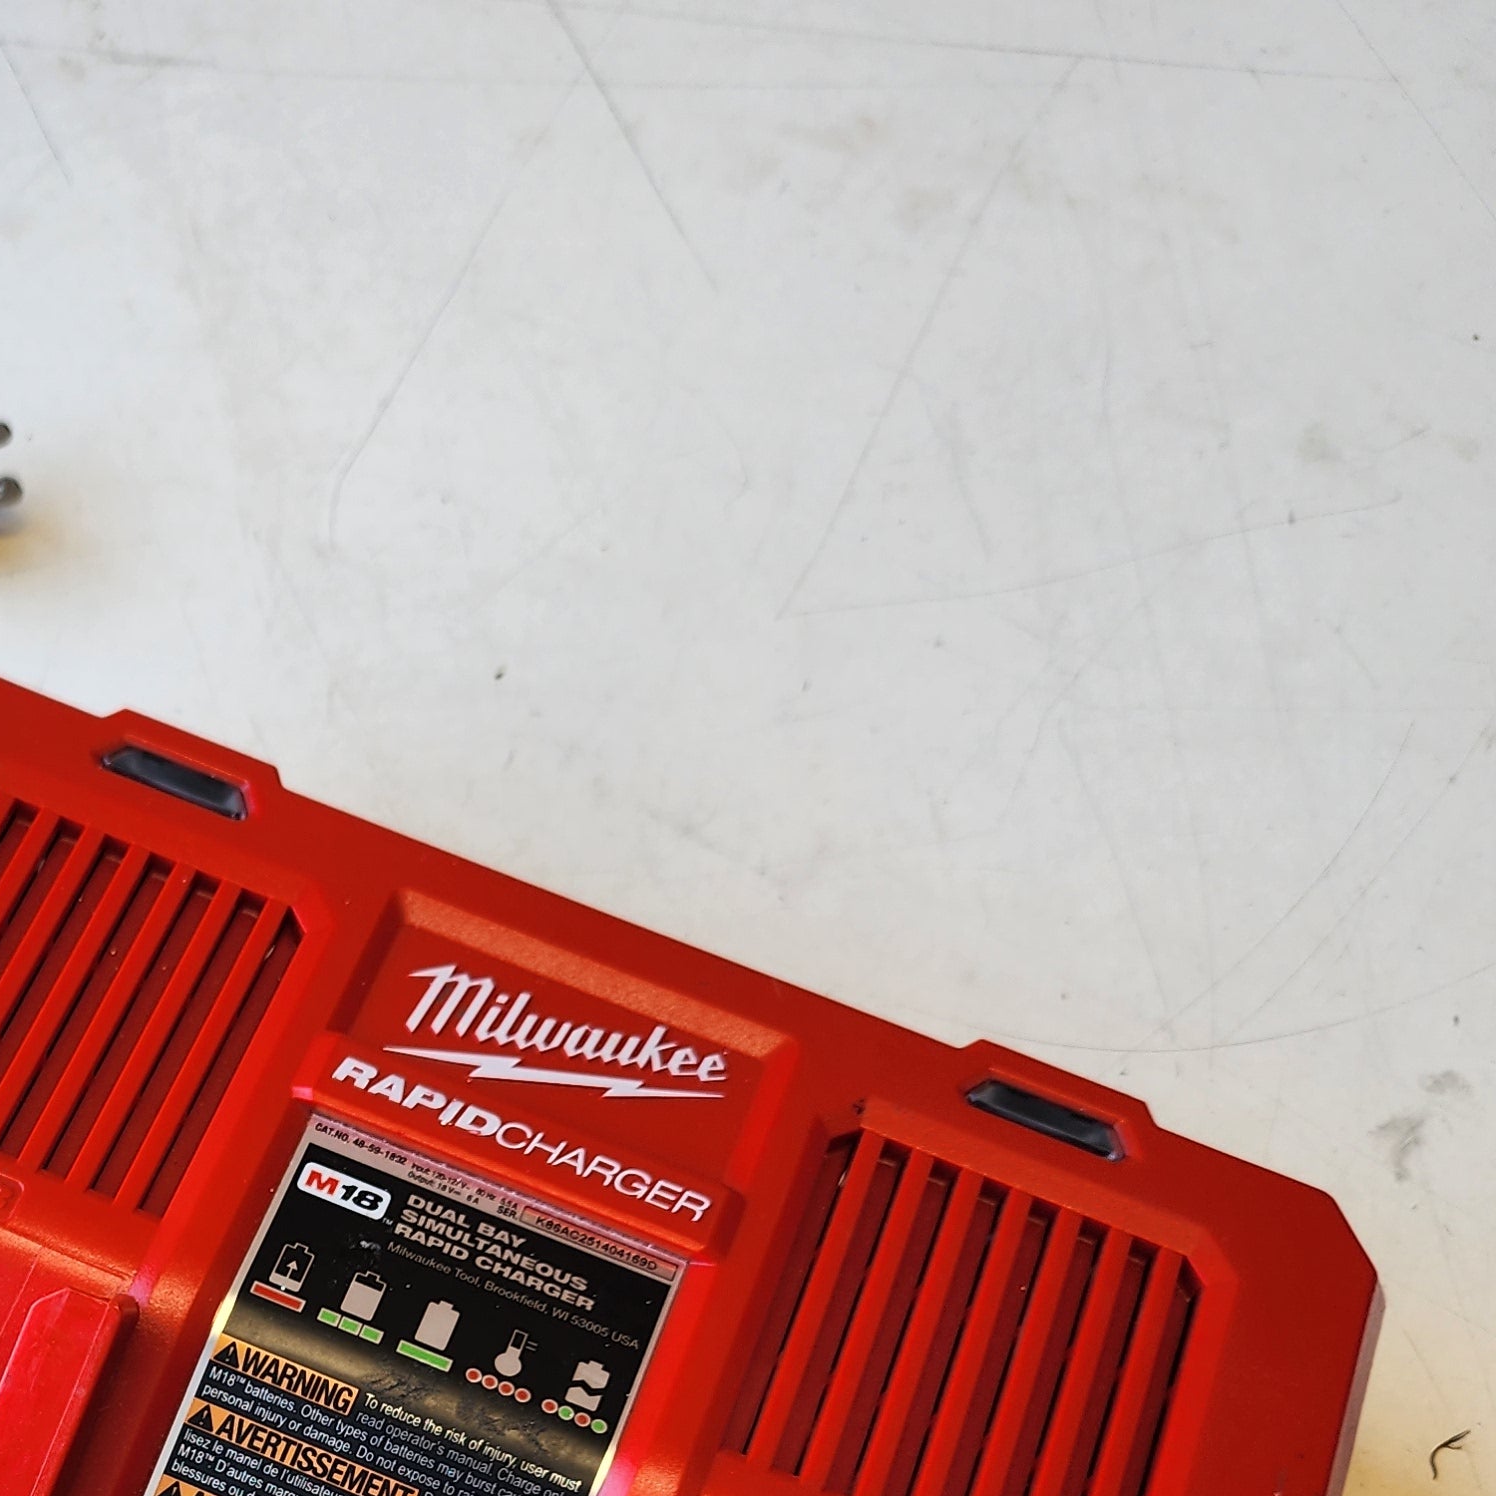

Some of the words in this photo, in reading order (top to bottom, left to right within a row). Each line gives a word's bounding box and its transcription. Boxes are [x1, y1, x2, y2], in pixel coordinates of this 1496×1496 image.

[405, 963, 727, 1082] Milwaukee
[331, 1056, 712, 1223] RAPIDCHARGER
[305, 1169, 384, 1213] M18
[406, 1194, 470, 1229] DUAL
[476, 1222, 527, 1248] BAY
[496, 1205, 518, 1221] SER.
[394, 1222, 470, 1261] RAPID
[474, 1255, 595, 1311] CHARGER
[400, 1208, 588, 1291] SIMULTANEOUS
[387, 1241, 452, 1274] Milwaukee
[454, 1267, 481, 1288] Tool,
[483, 1280, 548, 1315] Brookfield,
[552, 1307, 570, 1321] WI
[570, 1314, 609, 1338] 53005
[611, 1331, 639, 1350] USA
[239, 1348, 354, 1413] WARNING
[171, 1458, 227, 1492] blessures
[183, 1428, 212, 1450] lisez
[211, 1439, 224, 1455] le
[224, 1448, 263, 1471] manel
[262, 1462, 279, 1478] de
[201, 1384, 255, 1413] personal
[253, 1402, 288, 1429] injury
[288, 1419, 303, 1432] or
[302, 1424, 352, 1455] damage.
[355, 1444, 375, 1462] Do
[375, 1455, 397, 1472] not
[397, 1464, 441, 1490] expose
[442, 1481, 456, 1496] to
[214, 1458, 264, 1489] D'autres
[244, 1380, 297, 1413] batteries.
[300, 1403, 336, 1427] Other
[335, 1418, 369, 1442] types
[369, 1435, 385, 1448] of
[383, 1437, 436, 1469] batteries
[436, 1462, 465, 1483] may
[464, 1471, 497, 1495] burst
[355, 1412, 386, 1431] read
[382, 1420, 446, 1456] operator's
[445, 1449, 494, 1477] manual.
[497, 1467, 542, 1495] Charge
[364, 1392, 379, 1410] To
[379, 1402, 422, 1427] reduce
[422, 1418, 443, 1436] the
[444, 1427, 468, 1446] risk
[468, 1438, 485, 1452] of
[482, 1441, 518, 1469] injury,
[520, 1460, 550, 1479] user
[548, 1472, 582, 1493] must
